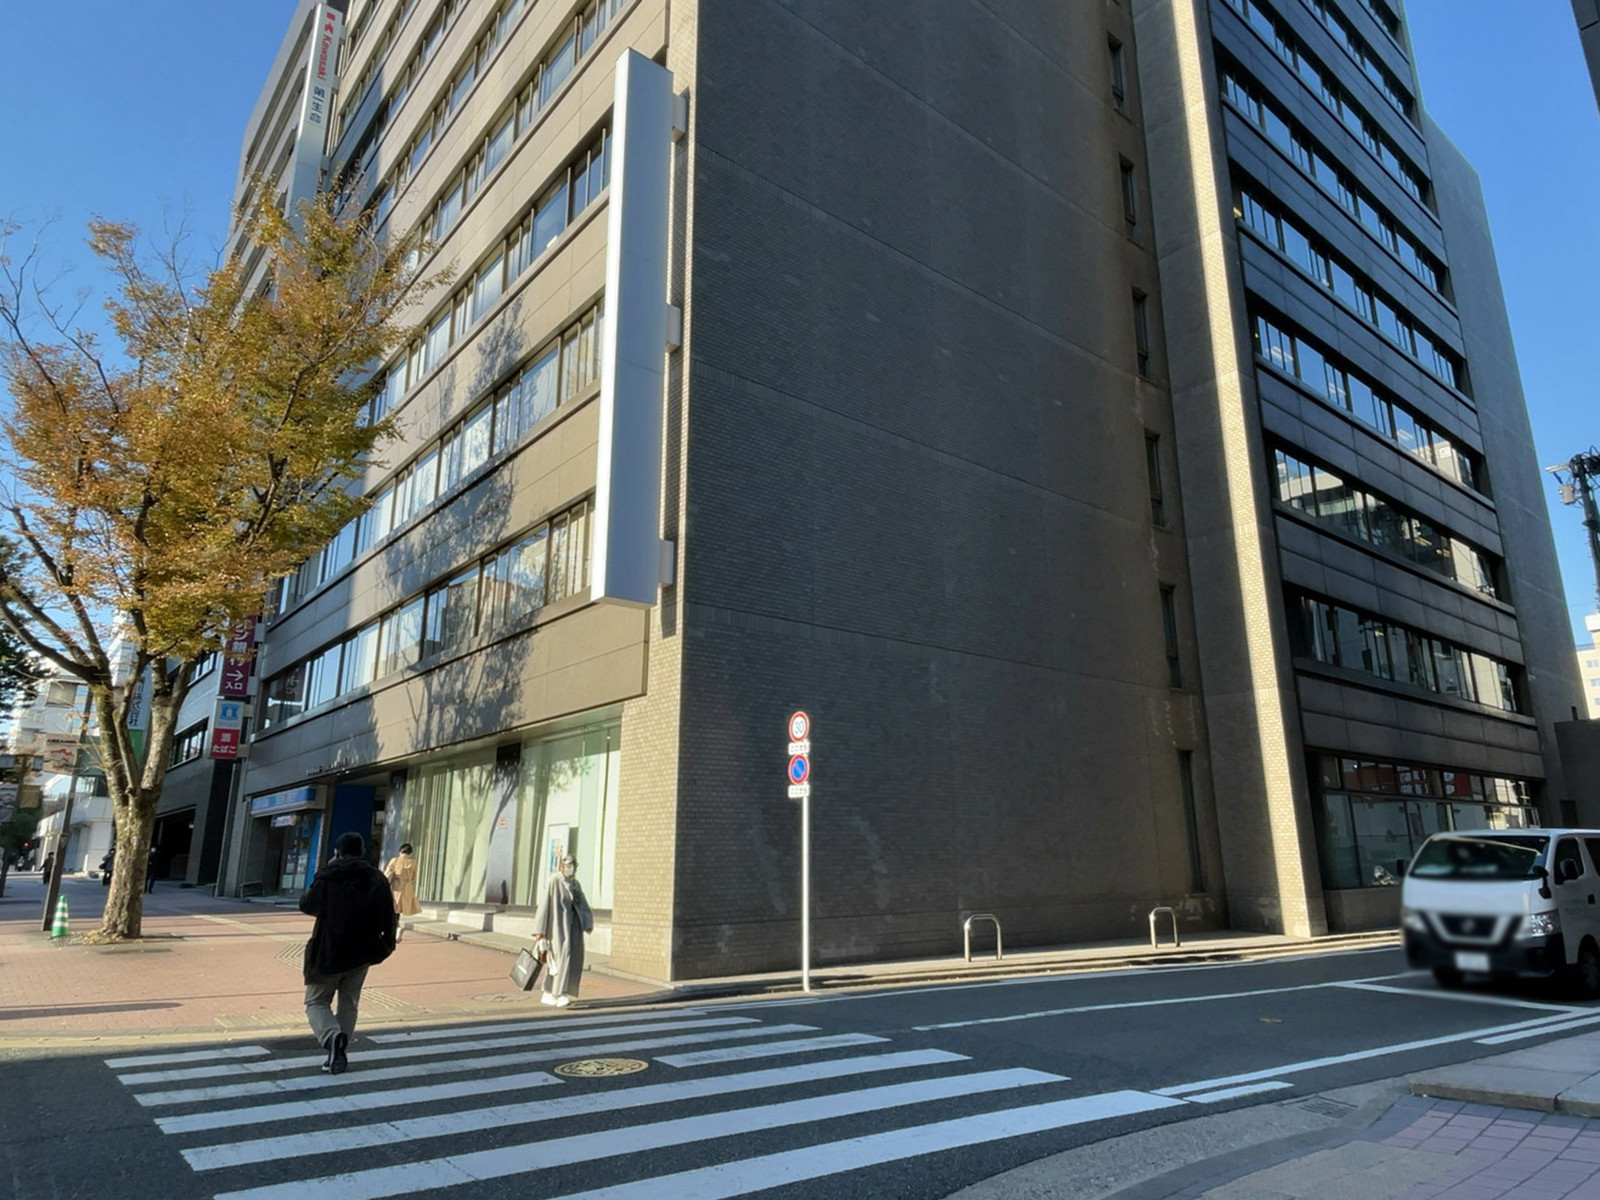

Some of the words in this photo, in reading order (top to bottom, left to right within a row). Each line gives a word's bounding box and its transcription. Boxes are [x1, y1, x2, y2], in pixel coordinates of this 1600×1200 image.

[317, 34, 332, 81] Kawasaki
[225, 681, 243, 691] 入口
[212, 745, 237, 754] たばこ
